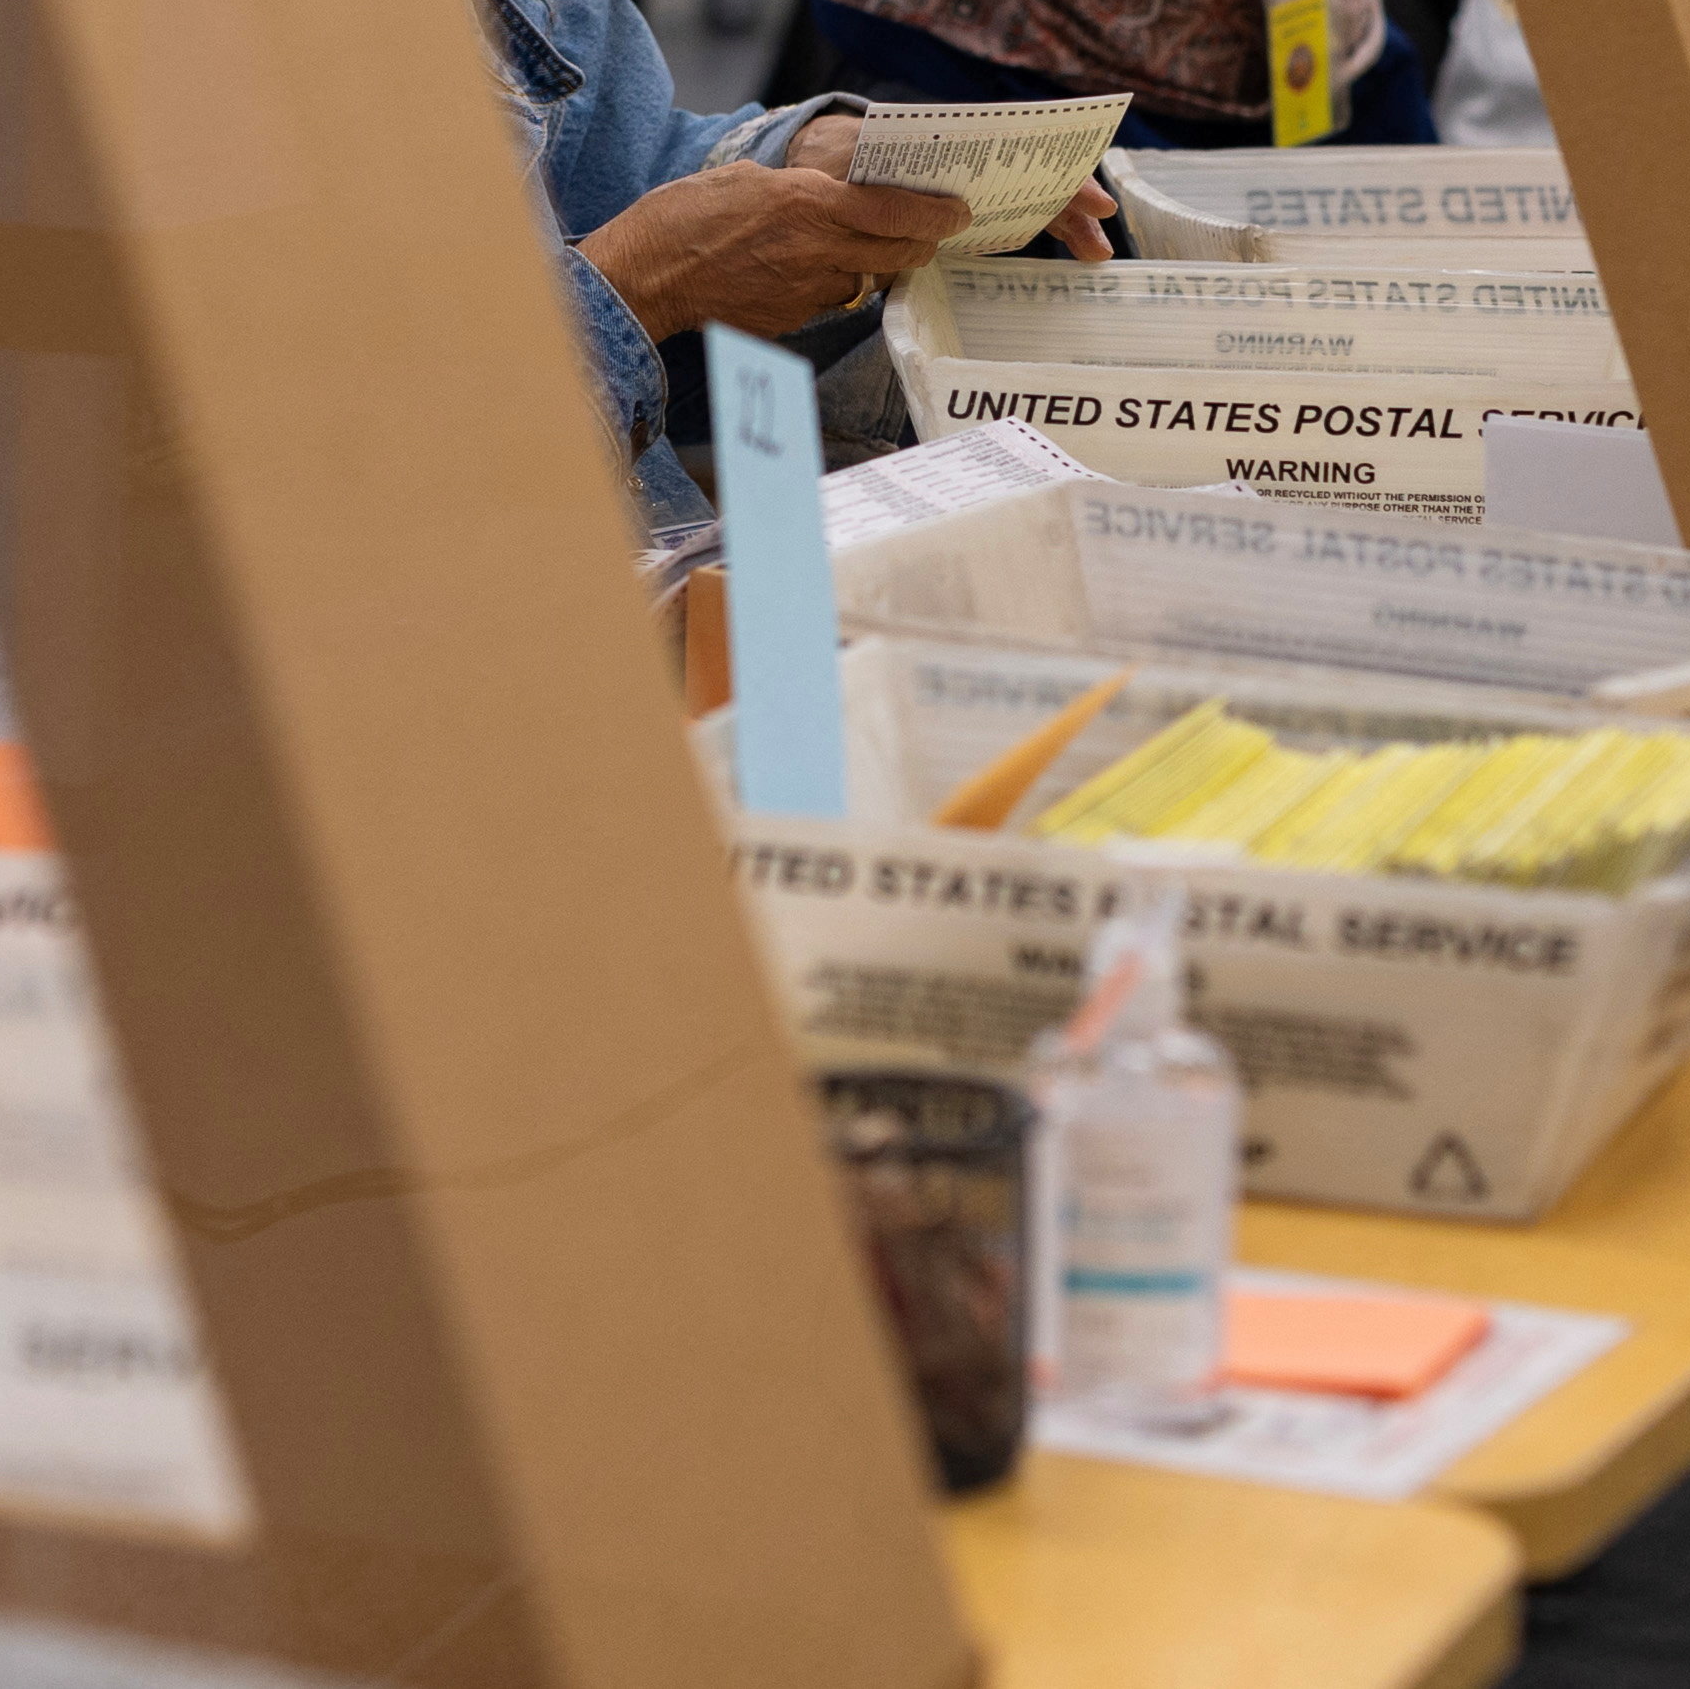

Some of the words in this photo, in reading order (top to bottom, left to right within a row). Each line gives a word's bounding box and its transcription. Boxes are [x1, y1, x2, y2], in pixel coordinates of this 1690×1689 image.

[947, 389, 1103, 427] UNITED
[1114, 397, 1282, 434] STATES
[1293, 404, 1464, 439] POSTAL
[1226, 458, 1376, 485] WARNING
[1257, 488, 1272, 498] OR
[1274, 489, 1331, 499] RECYCLED
[1333, 491, 1382, 501] WITHOUT
[1384, 493, 1405, 502] THE
[1407, 493, 1472, 503] PERMISSION
[1383, 503, 1419, 513] OTHER
[1422, 504, 1450, 514] THAN
[1453, 505, 1473, 514] THE
[870, 856, 1080, 917] STATES
[1094, 878, 1304, 946] PSTAL
[1335, 908, 1579, 975] SERVICE
